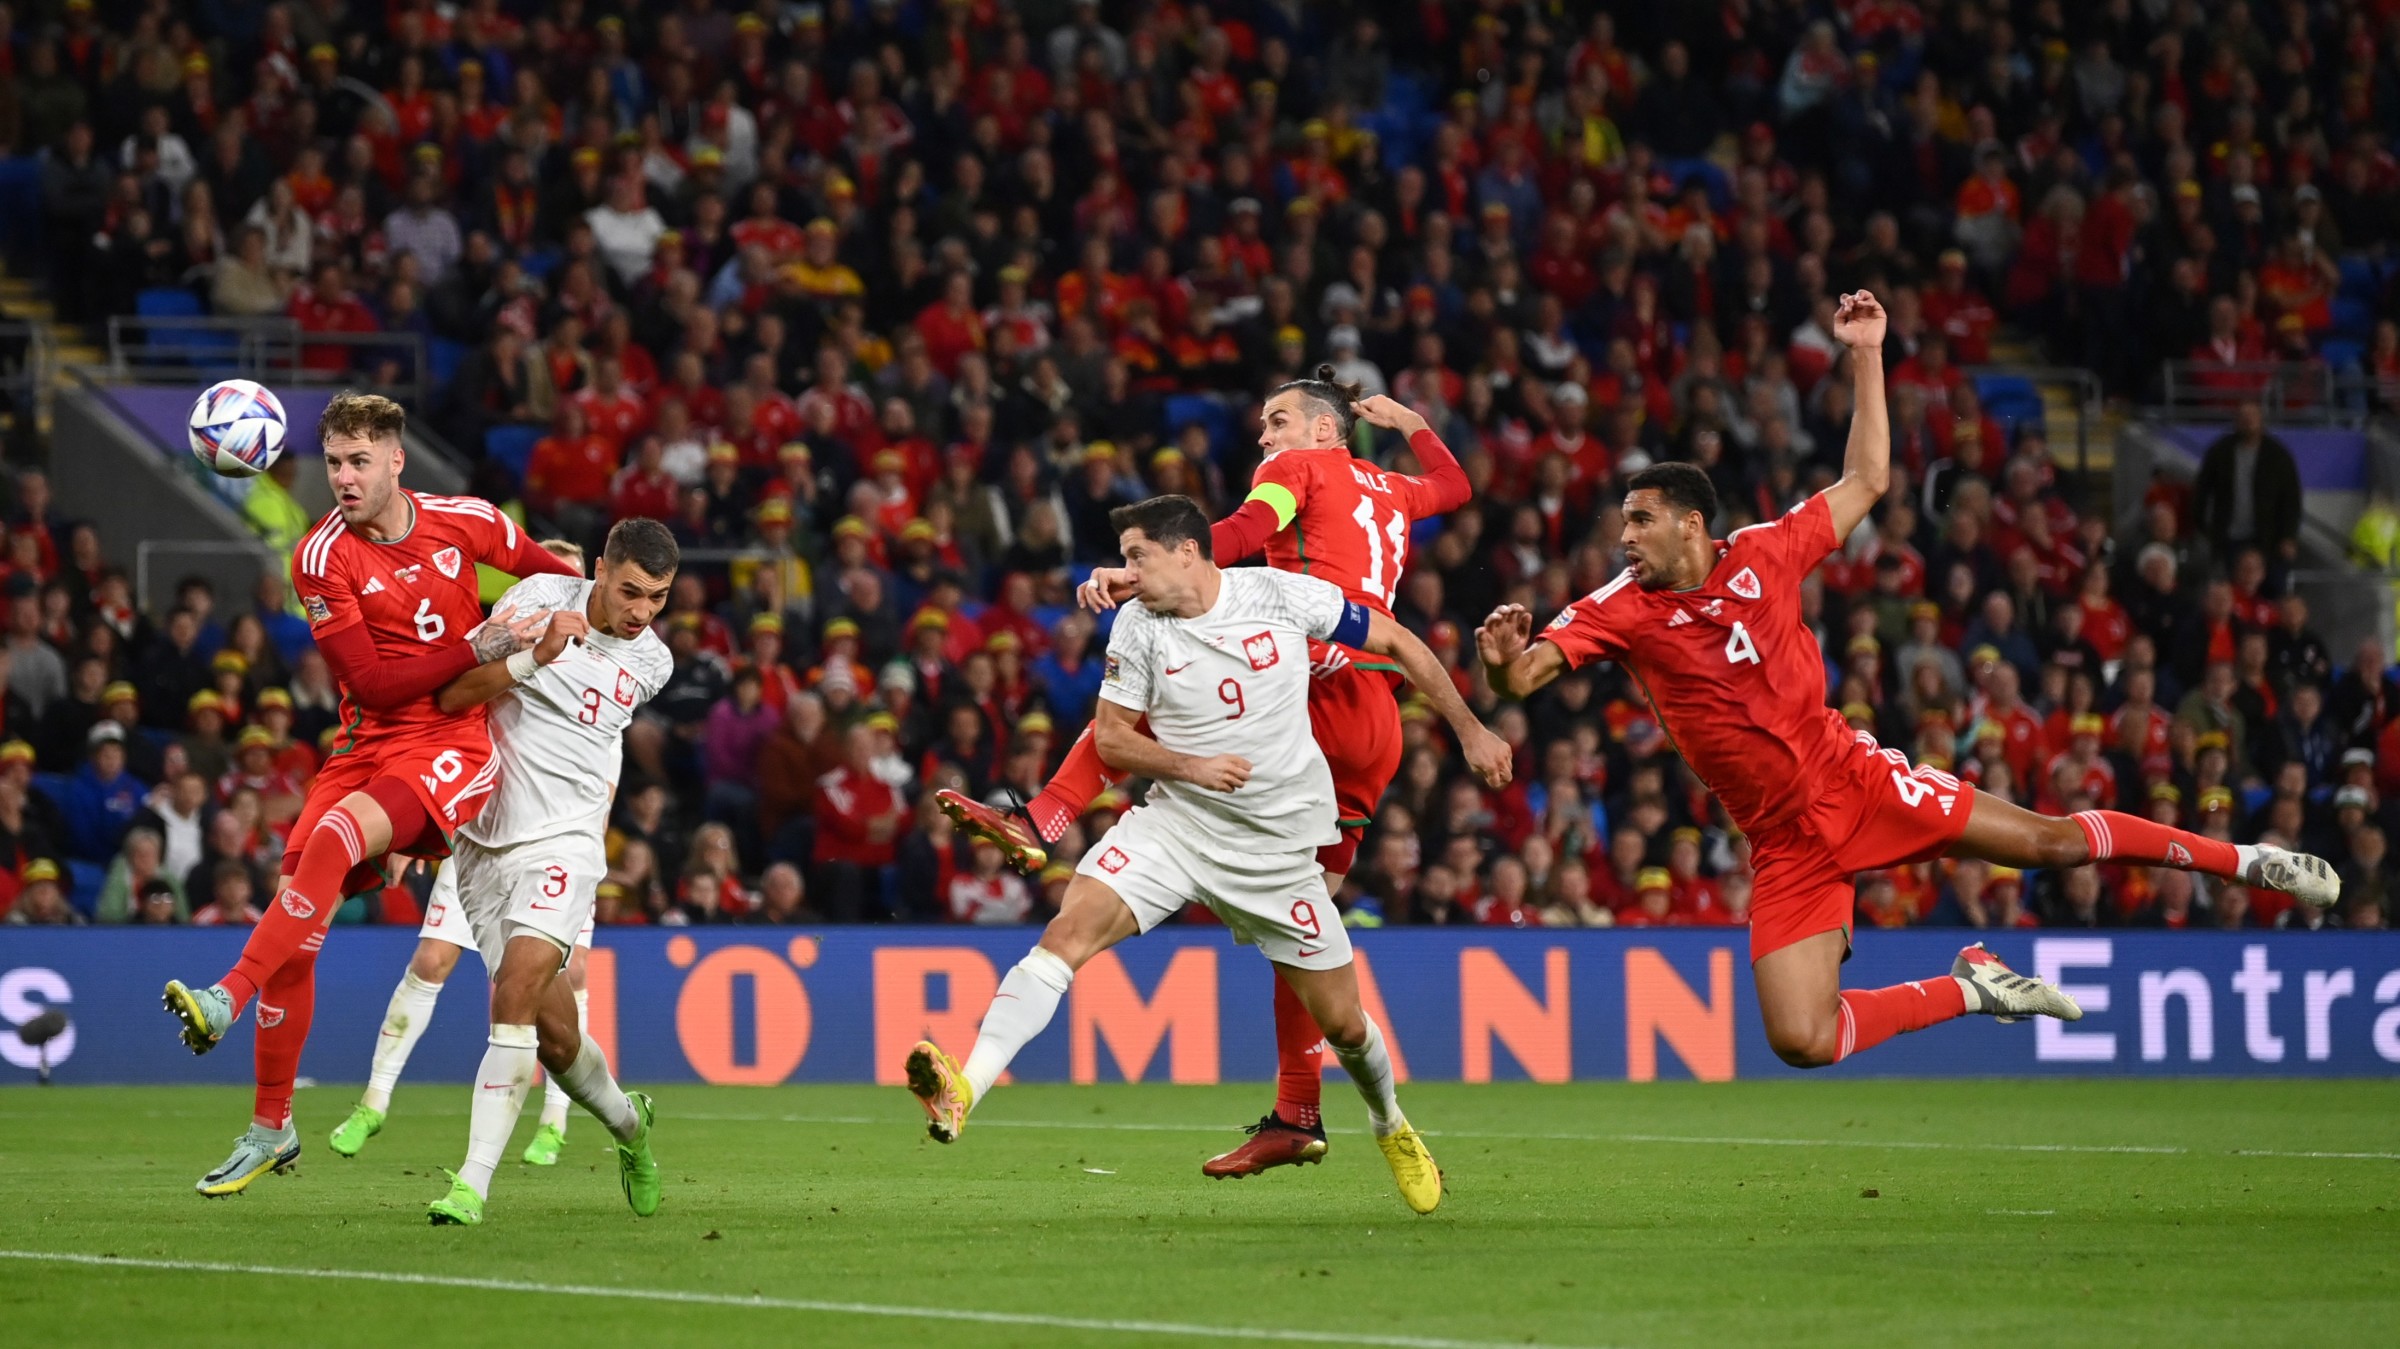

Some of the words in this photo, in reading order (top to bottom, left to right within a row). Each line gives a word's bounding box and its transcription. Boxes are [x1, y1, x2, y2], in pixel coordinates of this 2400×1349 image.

[1352, 494, 1405, 611] 11
[414, 598, 445, 641] 6
[1724, 620, 1761, 665] 4
[578, 687, 601, 726] 3
[1218, 677, 1245, 720] 9
[432, 750, 463, 783] 6
[1891, 769, 1935, 808] 4
[543, 865, 568, 898] 3
[1290, 900, 1321, 940] 9
